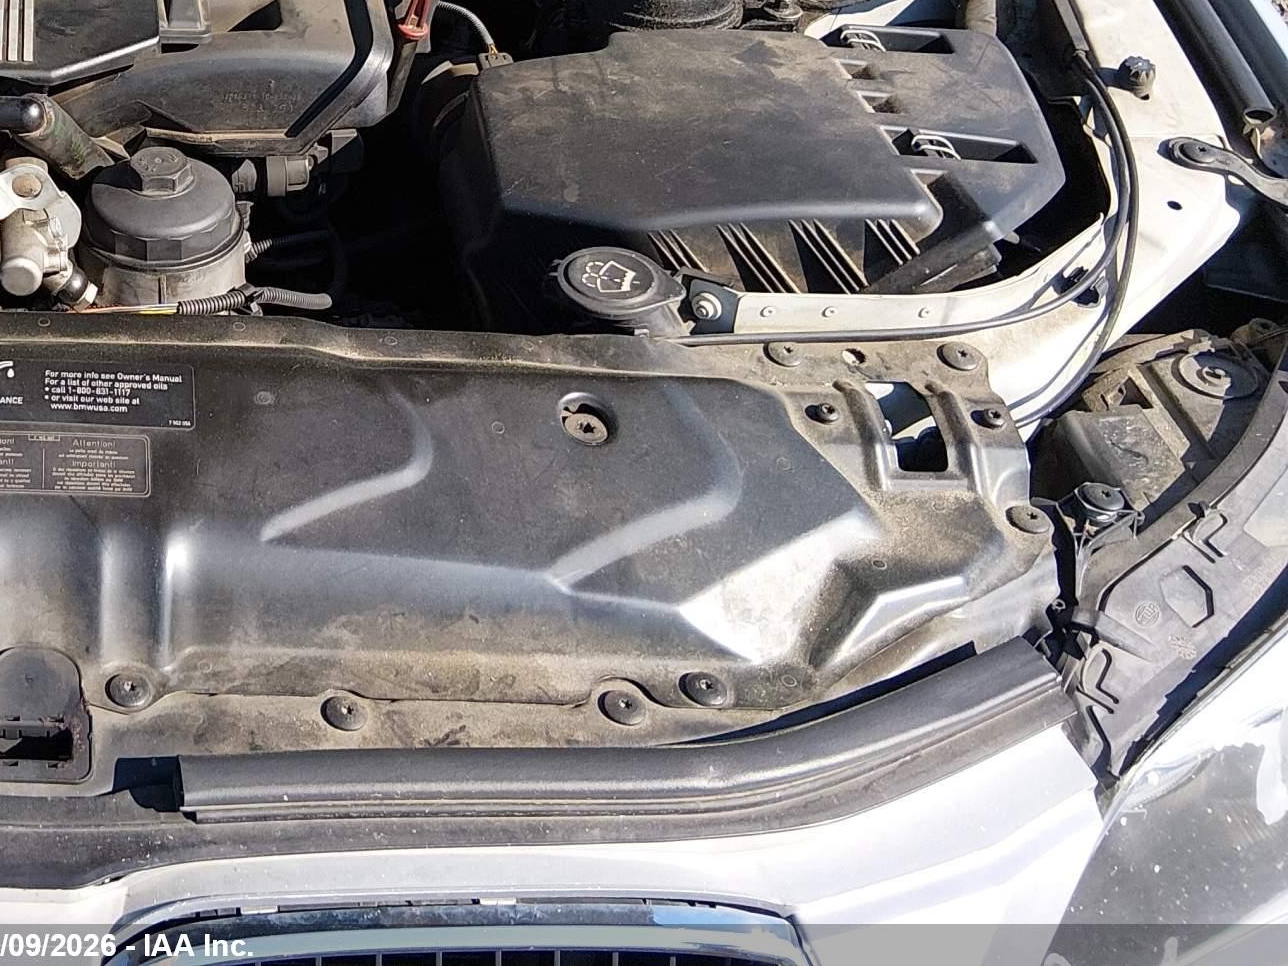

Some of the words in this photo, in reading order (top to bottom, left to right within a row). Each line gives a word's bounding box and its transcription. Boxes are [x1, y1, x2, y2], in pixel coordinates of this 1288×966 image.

[84, 371, 99, 379] info
[117, 372, 150, 381] Owner's
[152, 374, 182, 383] Manual
[44, 377, 59, 385] For
[67, 378, 80, 386] list
[91, 379, 112, 387] other
[114, 381, 152, 390] approved
[153, 382, 168, 390] oils
[51, 386, 66, 394] call
[62, 394, 78, 402] visit
[50, 403, 128, 412] www.bmwusa.com
[72, 439, 116, 448] Attention!
[72, 460, 116, 468] Important!
